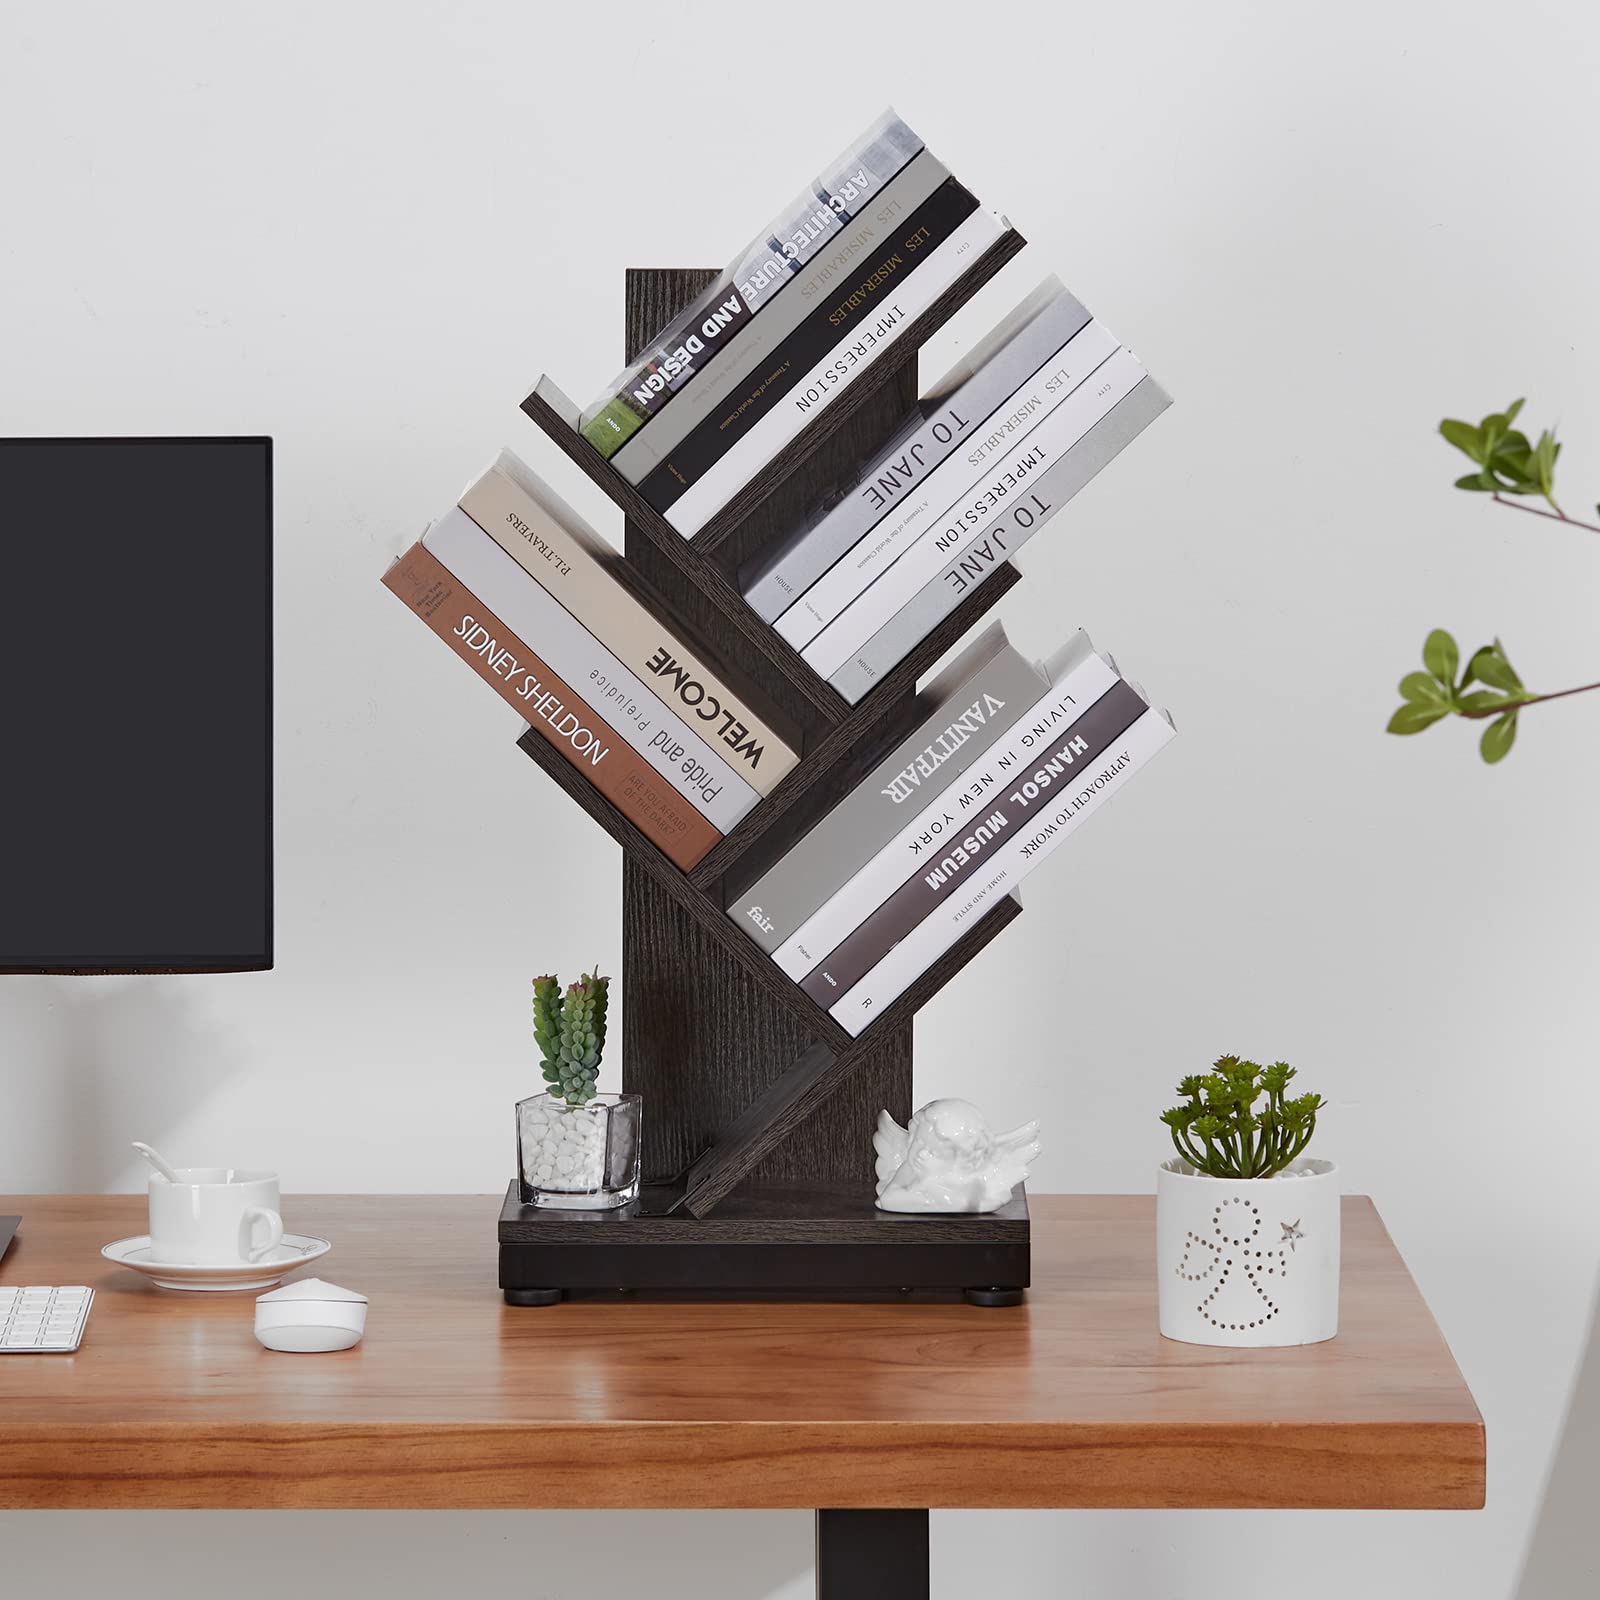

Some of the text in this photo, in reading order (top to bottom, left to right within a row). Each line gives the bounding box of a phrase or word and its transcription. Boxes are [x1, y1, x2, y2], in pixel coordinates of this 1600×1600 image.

[736, 168, 872, 302] ARCHITECTURE
[829, 226, 931, 326] LES MISERABLES
[698, 294, 743, 340] AND
[796, 304, 906, 412] IMPERESSION
[631, 333, 704, 406] DESIGN
[968, 369, 1070, 466] LES MISERABLES
[606, 417, 621, 433] ANDO
[862, 410, 970, 510] TO JANE
[935, 446, 1046, 552] IMPERESSION
[944, 495, 1052, 594] TO JANE
[775, 575, 793, 594] HOUSE
[453, 616, 609, 766] SIDNEY SHELDON
[645, 646, 764, 770] WELCOME
[857, 658, 877, 678] HOUSE
[590, 669, 723, 804] Pride and Prejudice
[881, 694, 1006, 803] VANITYFAIR
[908, 695, 1076, 855] LIVING IN NEW YORK
[924, 735, 1089, 891] HANSOL MUSEUM
[1020, 751, 1130, 859] APPROACH TO WORK
[746, 906, 774, 933] fair
[952, 870, 1007, 922] HOME AND STYLE
[822, 972, 837, 987] ANDO
[862, 997, 873, 1009] R
